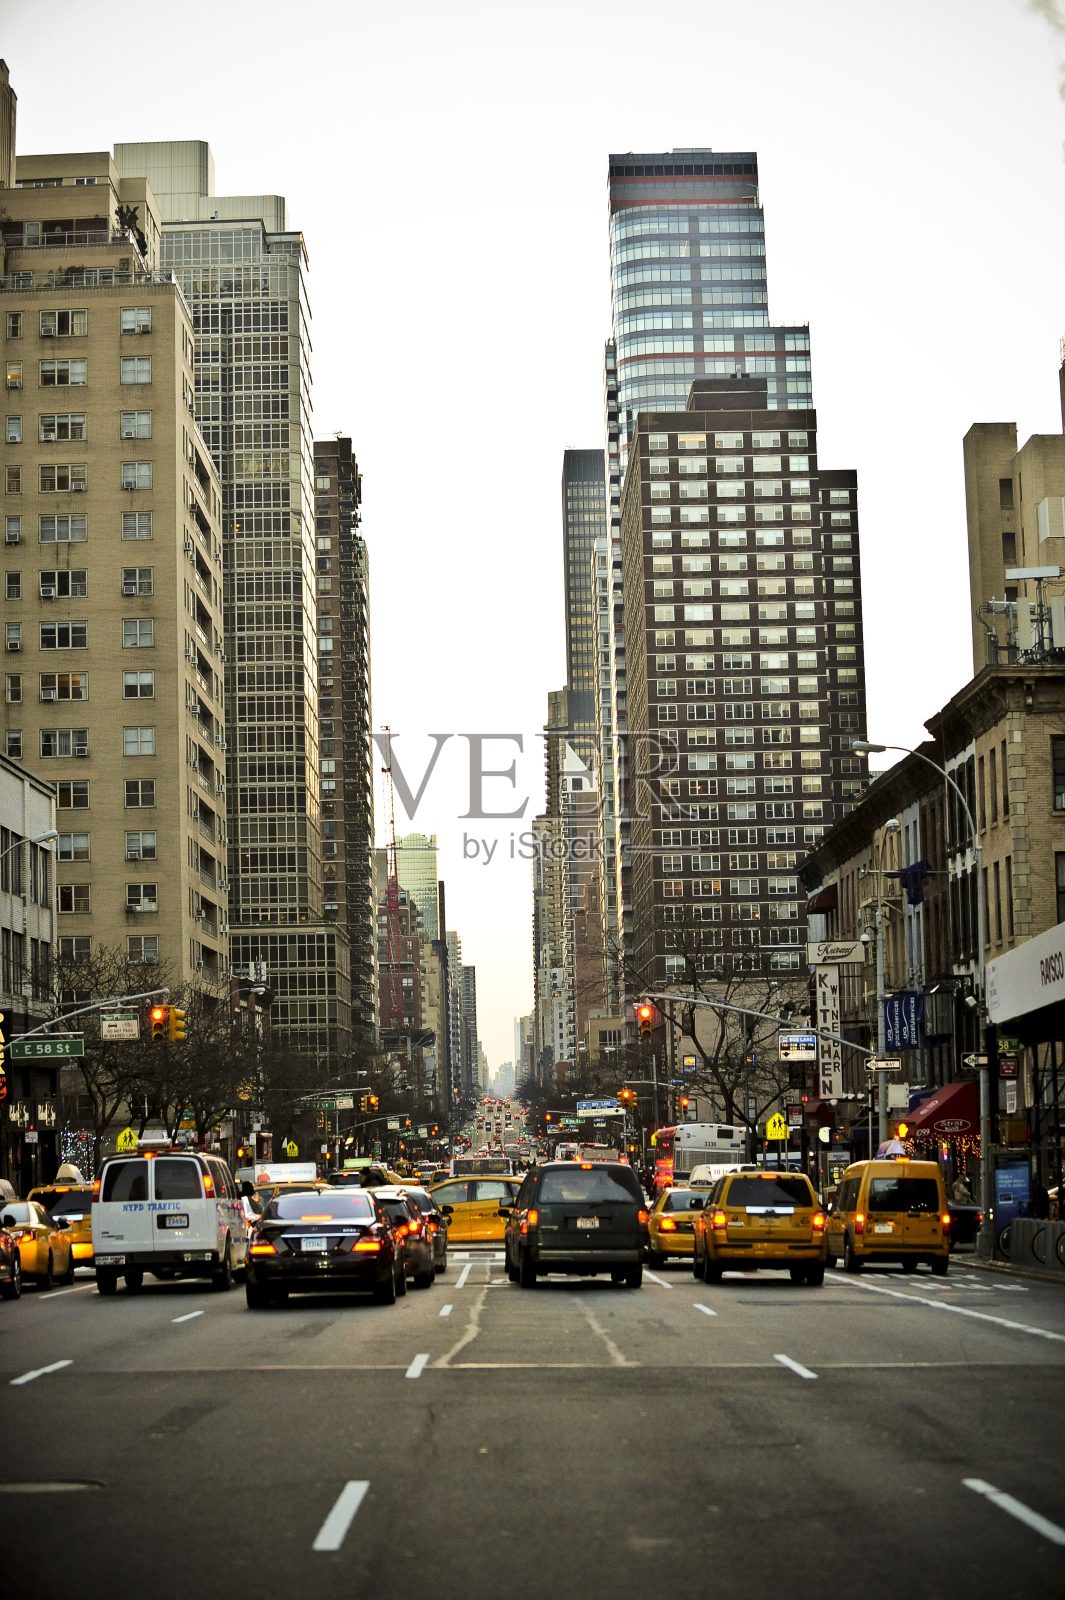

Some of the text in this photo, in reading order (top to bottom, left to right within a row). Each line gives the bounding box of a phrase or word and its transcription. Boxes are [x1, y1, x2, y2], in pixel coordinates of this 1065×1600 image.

[830, 984, 840, 1033] WINE
[818, 973, 834, 1096] KITCHEN
[998, 1041, 1009, 1050] 58
[25, 1043, 70, 1054] E 58 St
[833, 1040, 841, 1073] BAR
[122, 1202, 181, 1212] NYPD TRAFFIC
